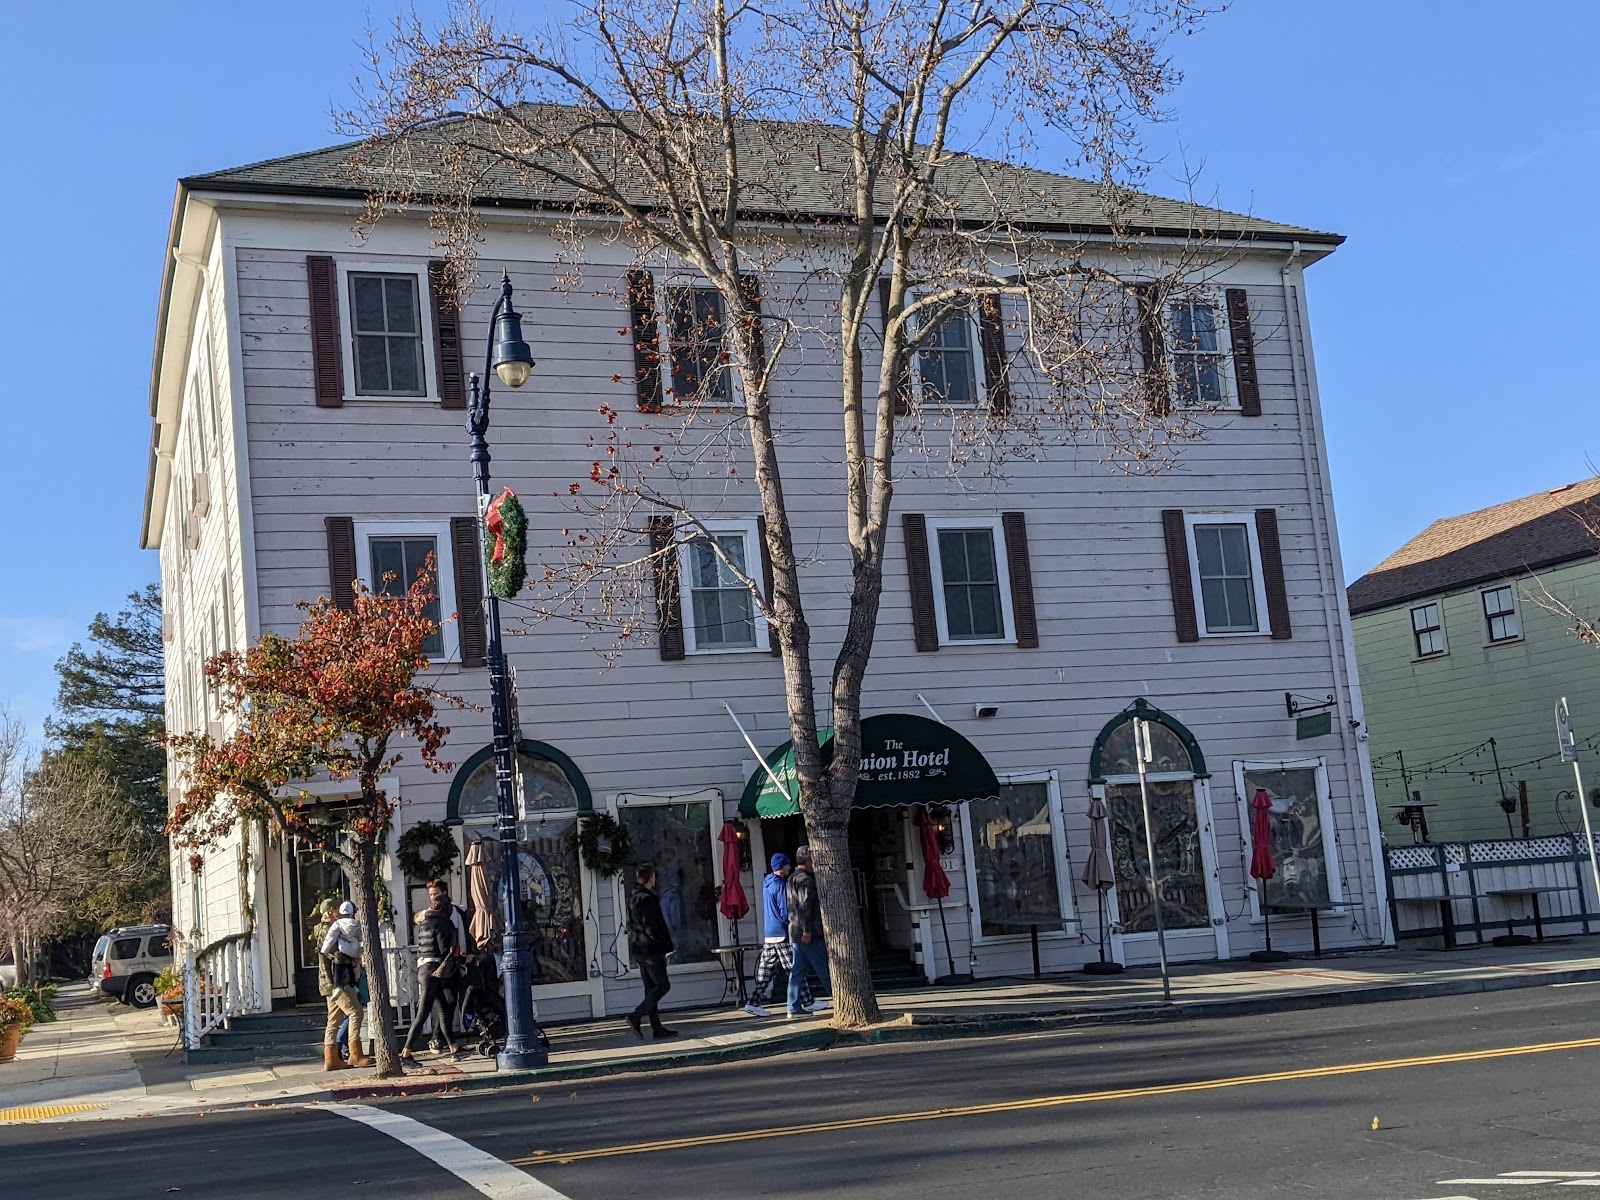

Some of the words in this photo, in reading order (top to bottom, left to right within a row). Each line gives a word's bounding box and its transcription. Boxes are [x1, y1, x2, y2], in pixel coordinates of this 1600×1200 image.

[884, 739, 903, 750] The
[859, 753, 897, 770] nion
[902, 748, 949, 767] Hotel
[941, 860, 954, 870] 01
